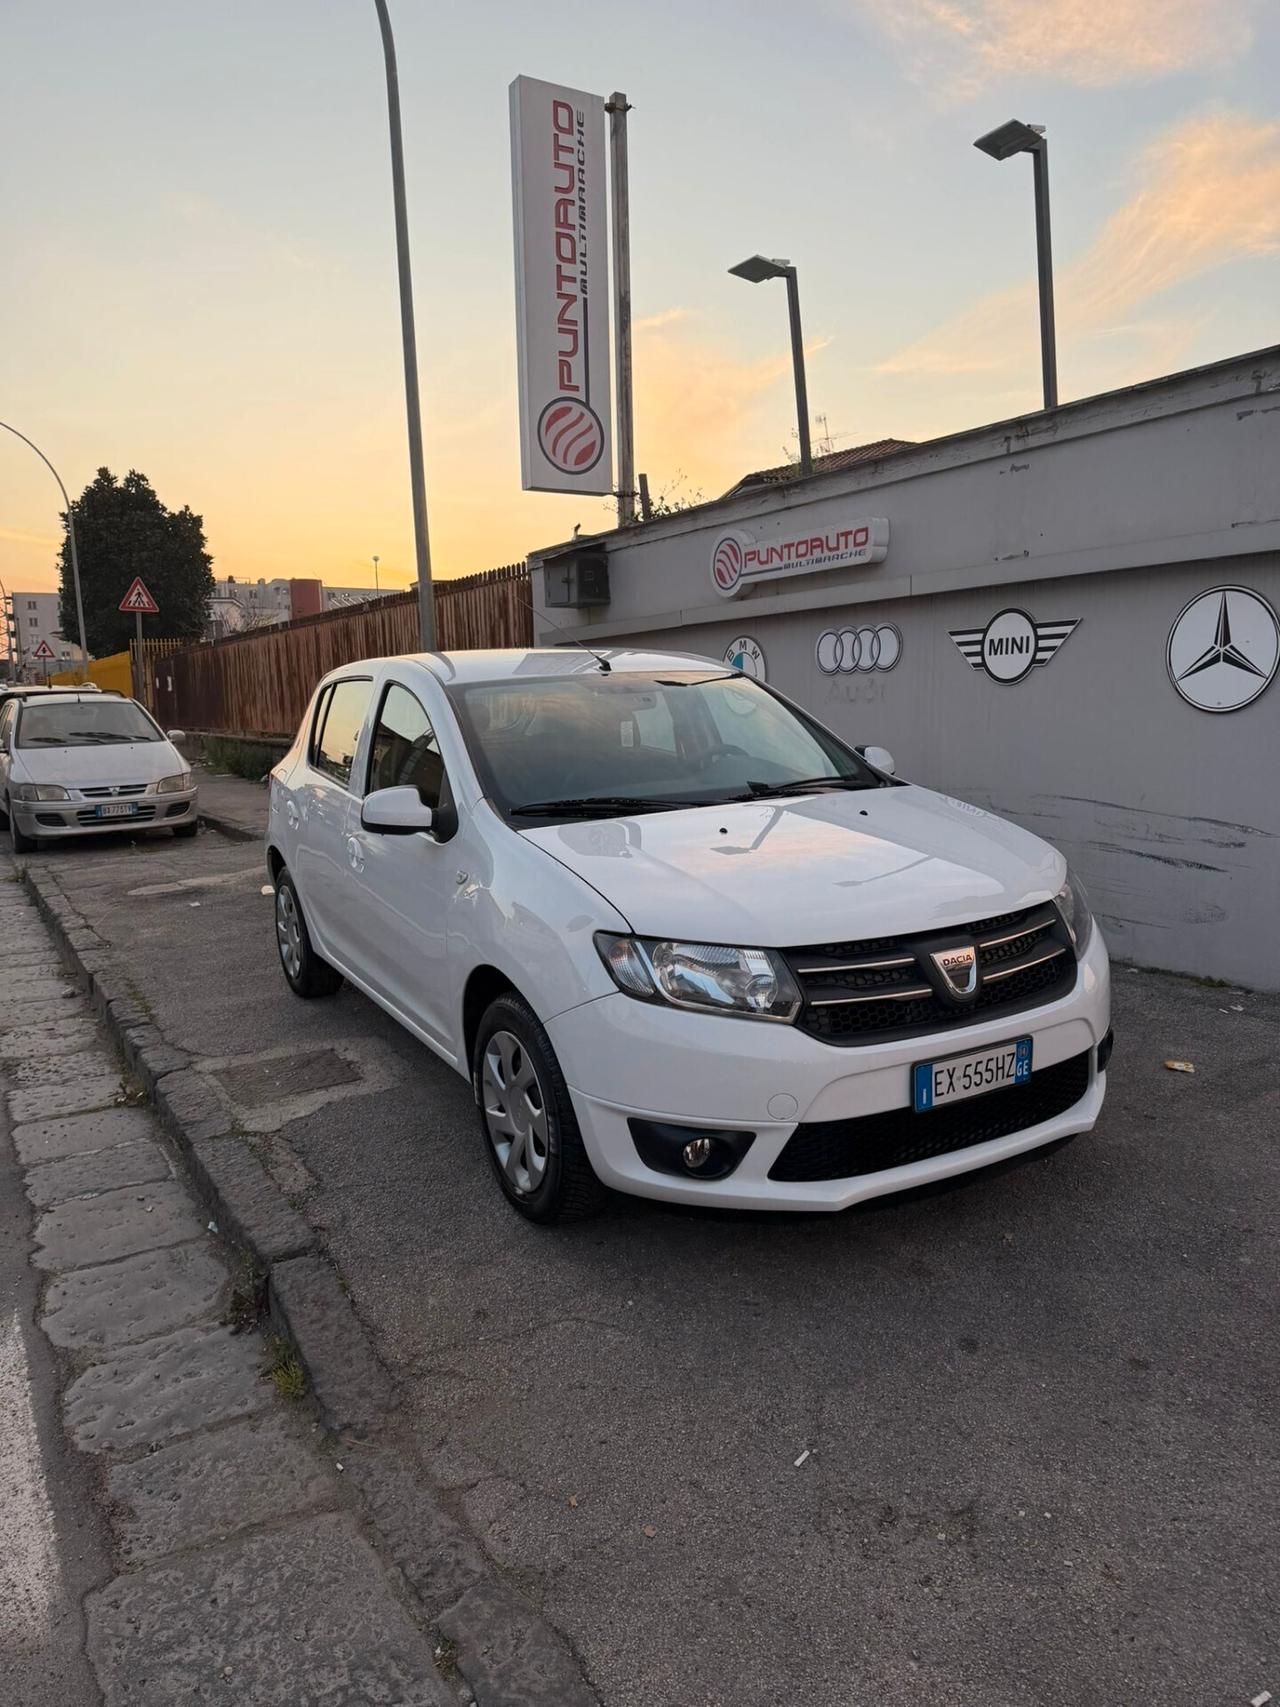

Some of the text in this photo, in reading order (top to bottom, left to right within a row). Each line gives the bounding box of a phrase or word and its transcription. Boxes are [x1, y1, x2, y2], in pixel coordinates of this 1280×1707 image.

[576, 109, 588, 296] MULTIMARCHE
[553, 99, 580, 392] PUNTOAUTO
[744, 527, 869, 568] PUNTOAUTO
[783, 549, 867, 570] MULTIMARCHE
[727, 640, 760, 662] BMW
[988, 636, 1031, 656] MINI
[943, 954, 973, 966] DACIA
[1016, 1059, 1029, 1077] GE
